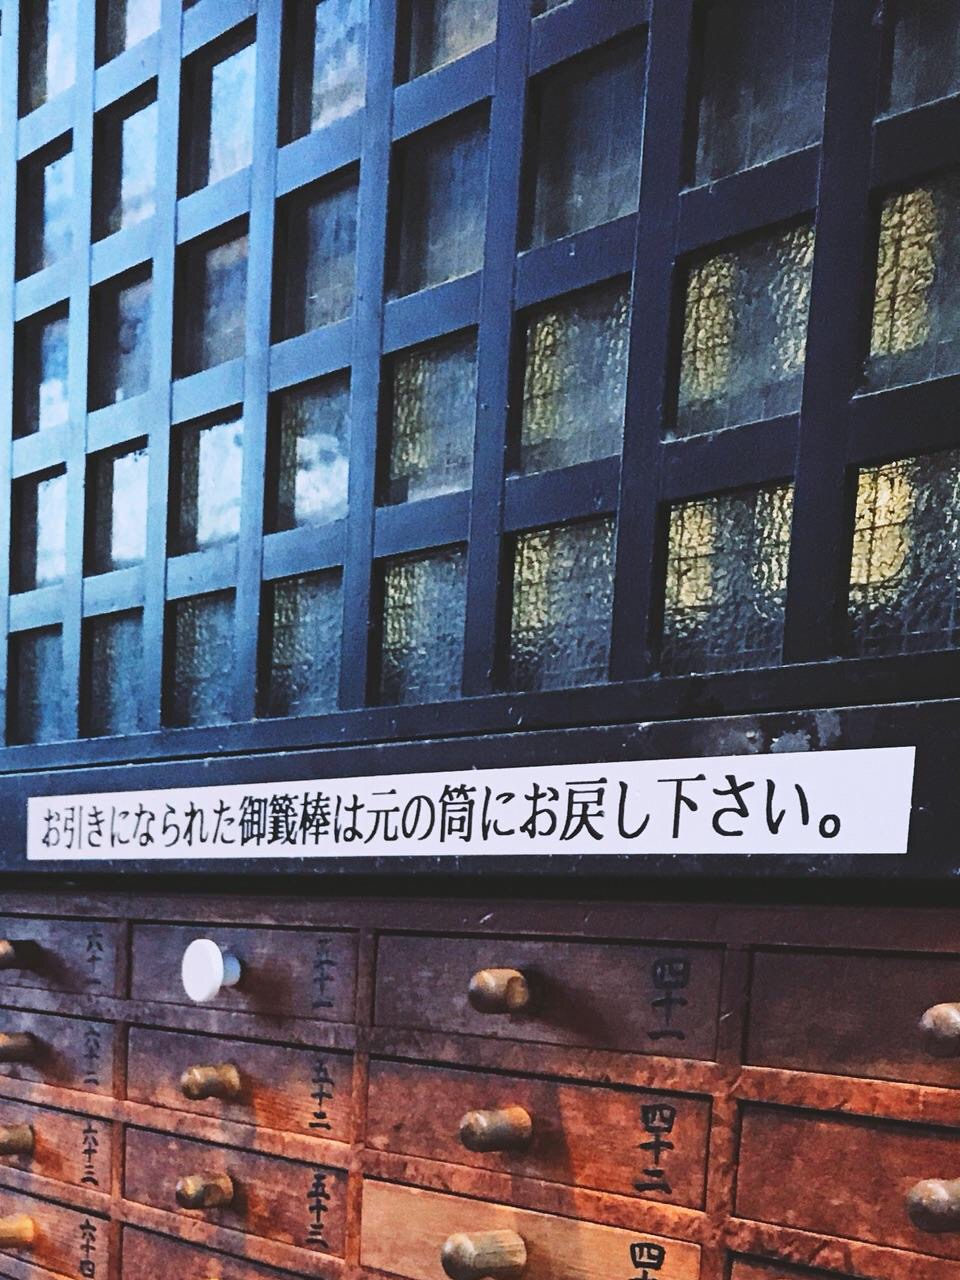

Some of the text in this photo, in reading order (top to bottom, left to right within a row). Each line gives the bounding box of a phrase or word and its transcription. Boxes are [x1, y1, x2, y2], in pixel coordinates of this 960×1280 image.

[42, 774, 841, 850] お引きになられた御籤棒は元の筒にお戻し下さい。
[647, 957, 691, 1041] 四十一
[82, 1025, 101, 1086] 六十二
[308, 1058, 336, 1131] 五十二
[80, 1120, 100, 1186] 六十三
[632, 1103, 677, 1195] 四十二
[305, 1171, 331, 1249] 五十三
[79, 1218, 98, 1279] 六十四
